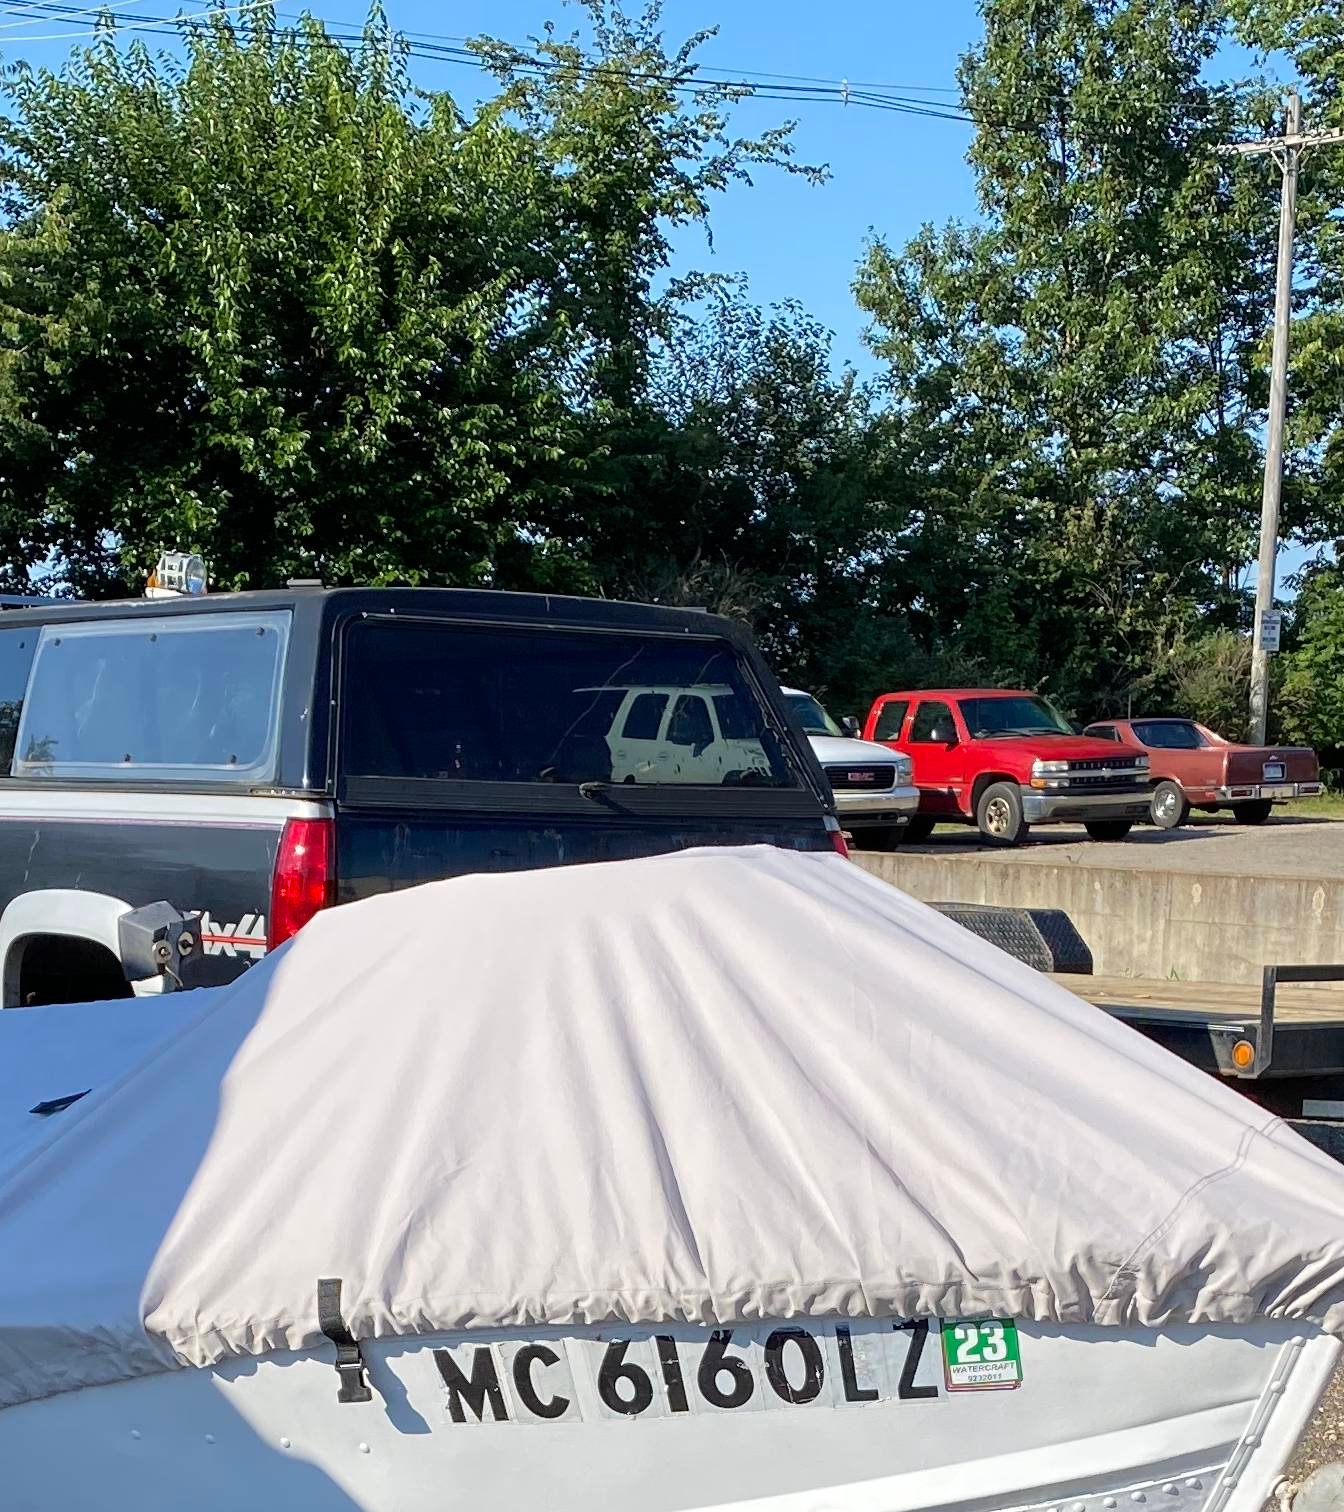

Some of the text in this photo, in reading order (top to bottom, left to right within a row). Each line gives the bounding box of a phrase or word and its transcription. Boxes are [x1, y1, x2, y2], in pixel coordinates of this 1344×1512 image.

[847, 772, 875, 781] GMC
[954, 1320, 1008, 1363] 23
[952, 1361, 1015, 1374] WATERCRAFT
[433, 1344, 570, 1423] MC
